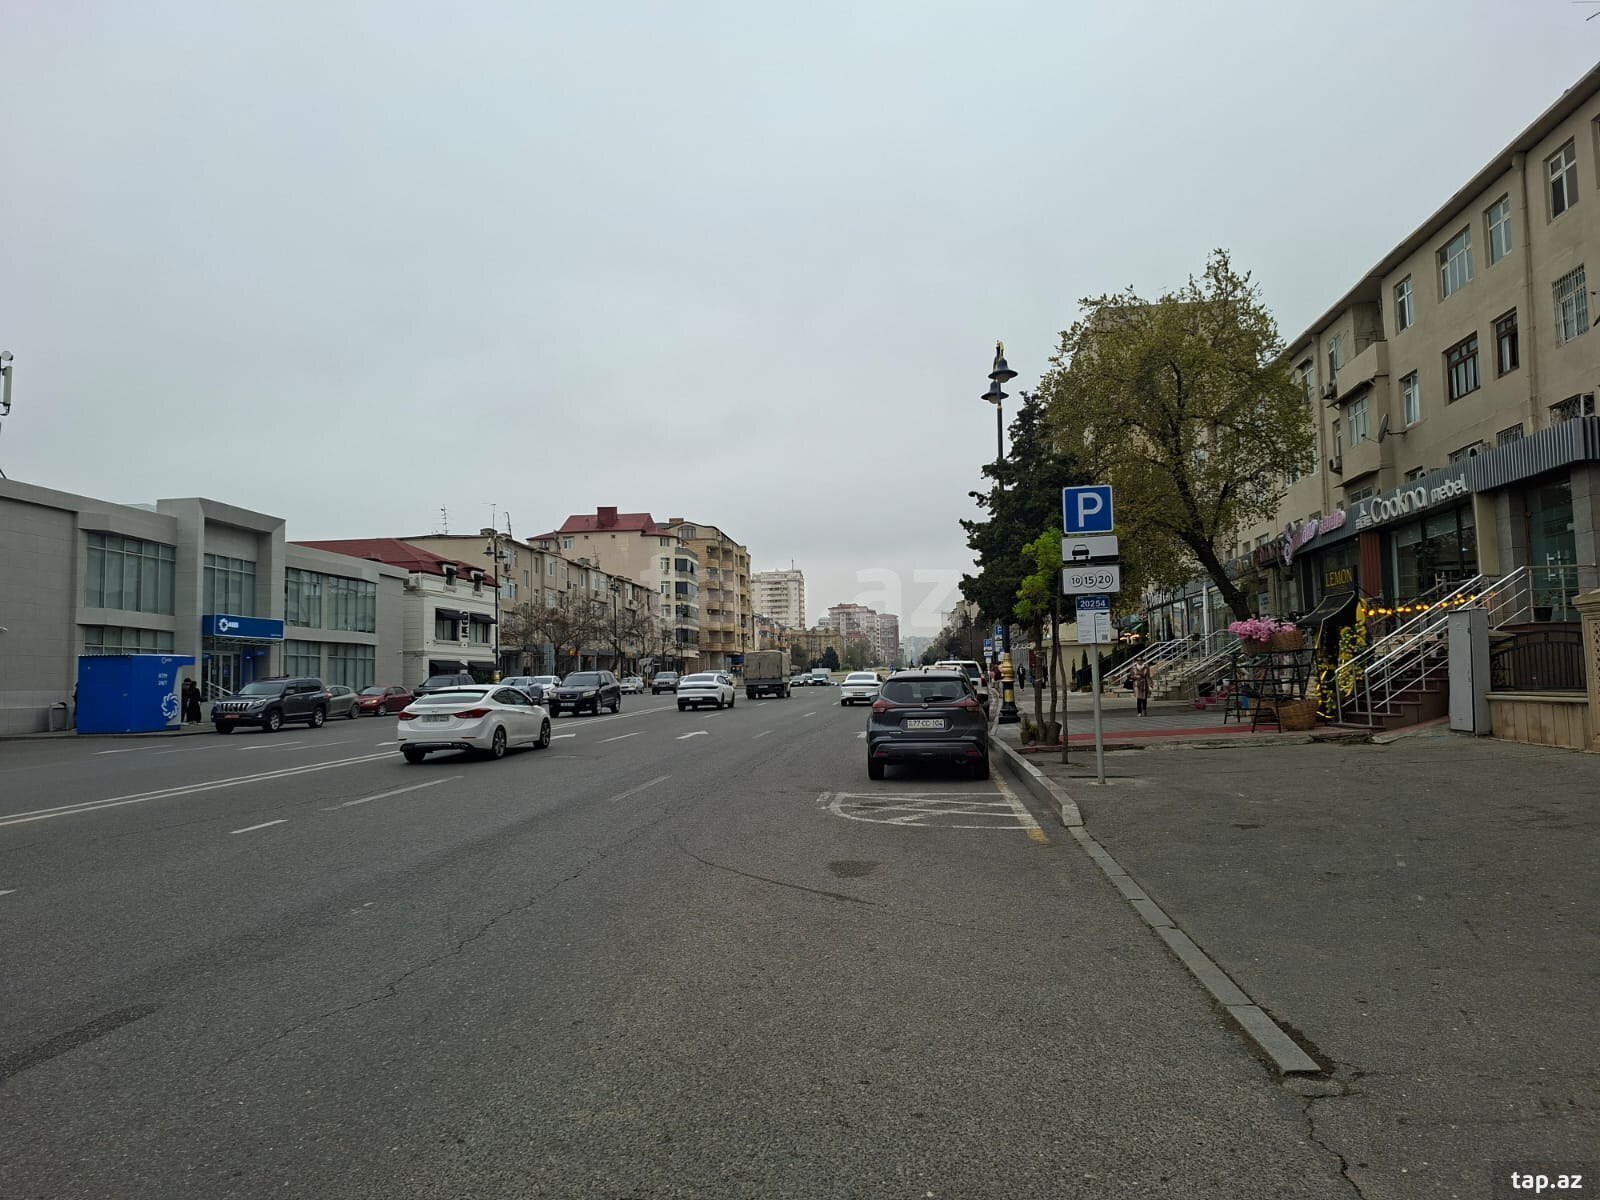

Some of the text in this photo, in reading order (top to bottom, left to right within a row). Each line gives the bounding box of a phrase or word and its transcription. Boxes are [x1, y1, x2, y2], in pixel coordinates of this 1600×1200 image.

[1431, 474, 1468, 504] mebel
[1077, 493, 1103, 528] P
[1071, 575, 1111, 585] 10 15 20
[1325, 567, 1353, 588] LEMON
[1080, 599, 1106, 608] 20254
